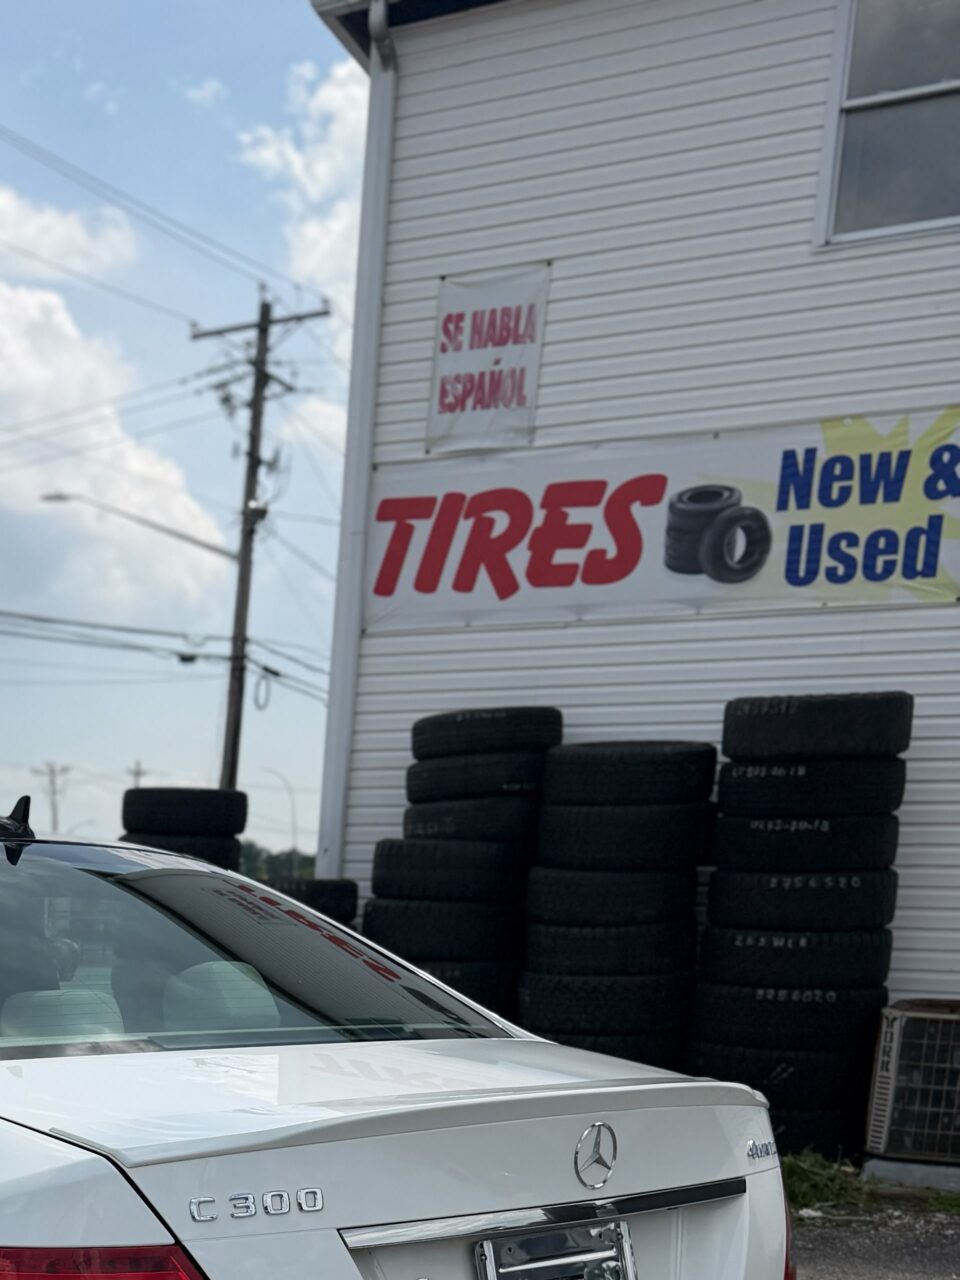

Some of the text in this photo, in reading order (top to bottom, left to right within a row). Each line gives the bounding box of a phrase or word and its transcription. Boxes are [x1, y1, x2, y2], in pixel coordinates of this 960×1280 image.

[440, 303, 536, 353] SE HABLA
[438, 357, 527, 414] ESPAÑOL
[776, 443, 960, 512] New &
[373, 474, 668, 600] TIRES
[784, 514, 944, 587] Used
[880, 1015, 899, 1073] YORK
[189, 1187, 324, 1222] C 300
